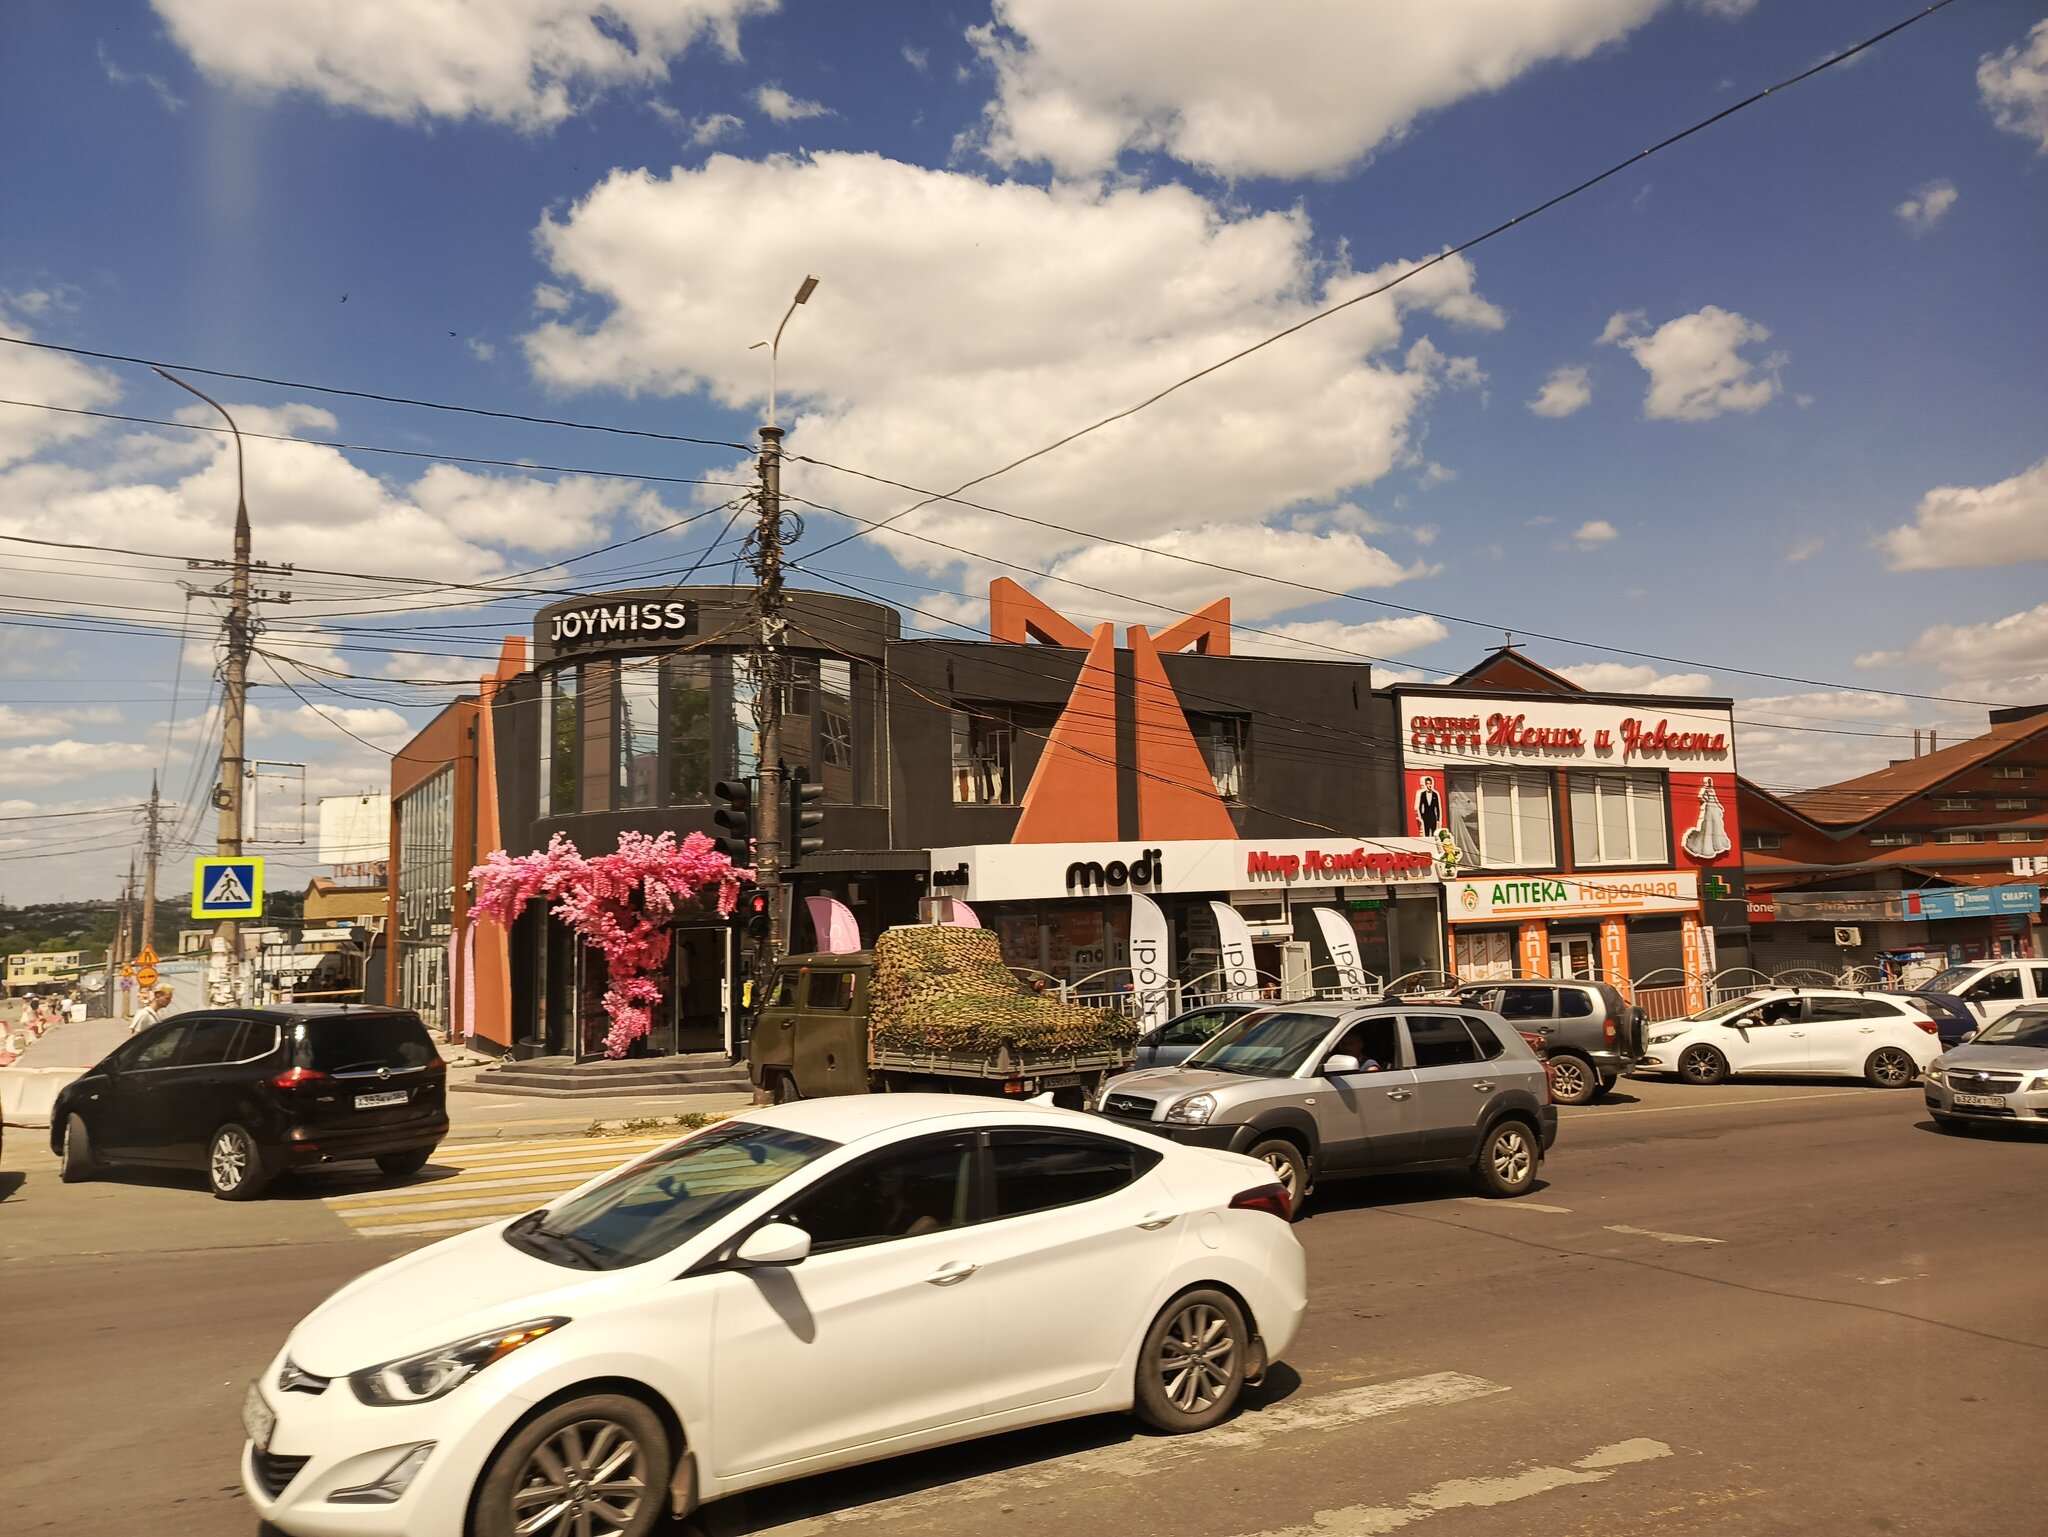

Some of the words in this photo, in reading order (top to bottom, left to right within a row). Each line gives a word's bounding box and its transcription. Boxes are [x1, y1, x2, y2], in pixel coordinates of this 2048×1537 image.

[551, 603, 686, 641] JOYMISS
[1486, 713, 1587, 748] Жених
[1594, 729, 1616, 749] и
[1620, 717, 1730, 756] Невеста
[1065, 848, 1162, 889] modi
[1248, 850, 1300, 877] Мир
[1303, 847, 1433, 875] Ломбардов
[1491, 882, 1568, 905] АПТЕКА
[1578, 881, 1678, 903] Народная
